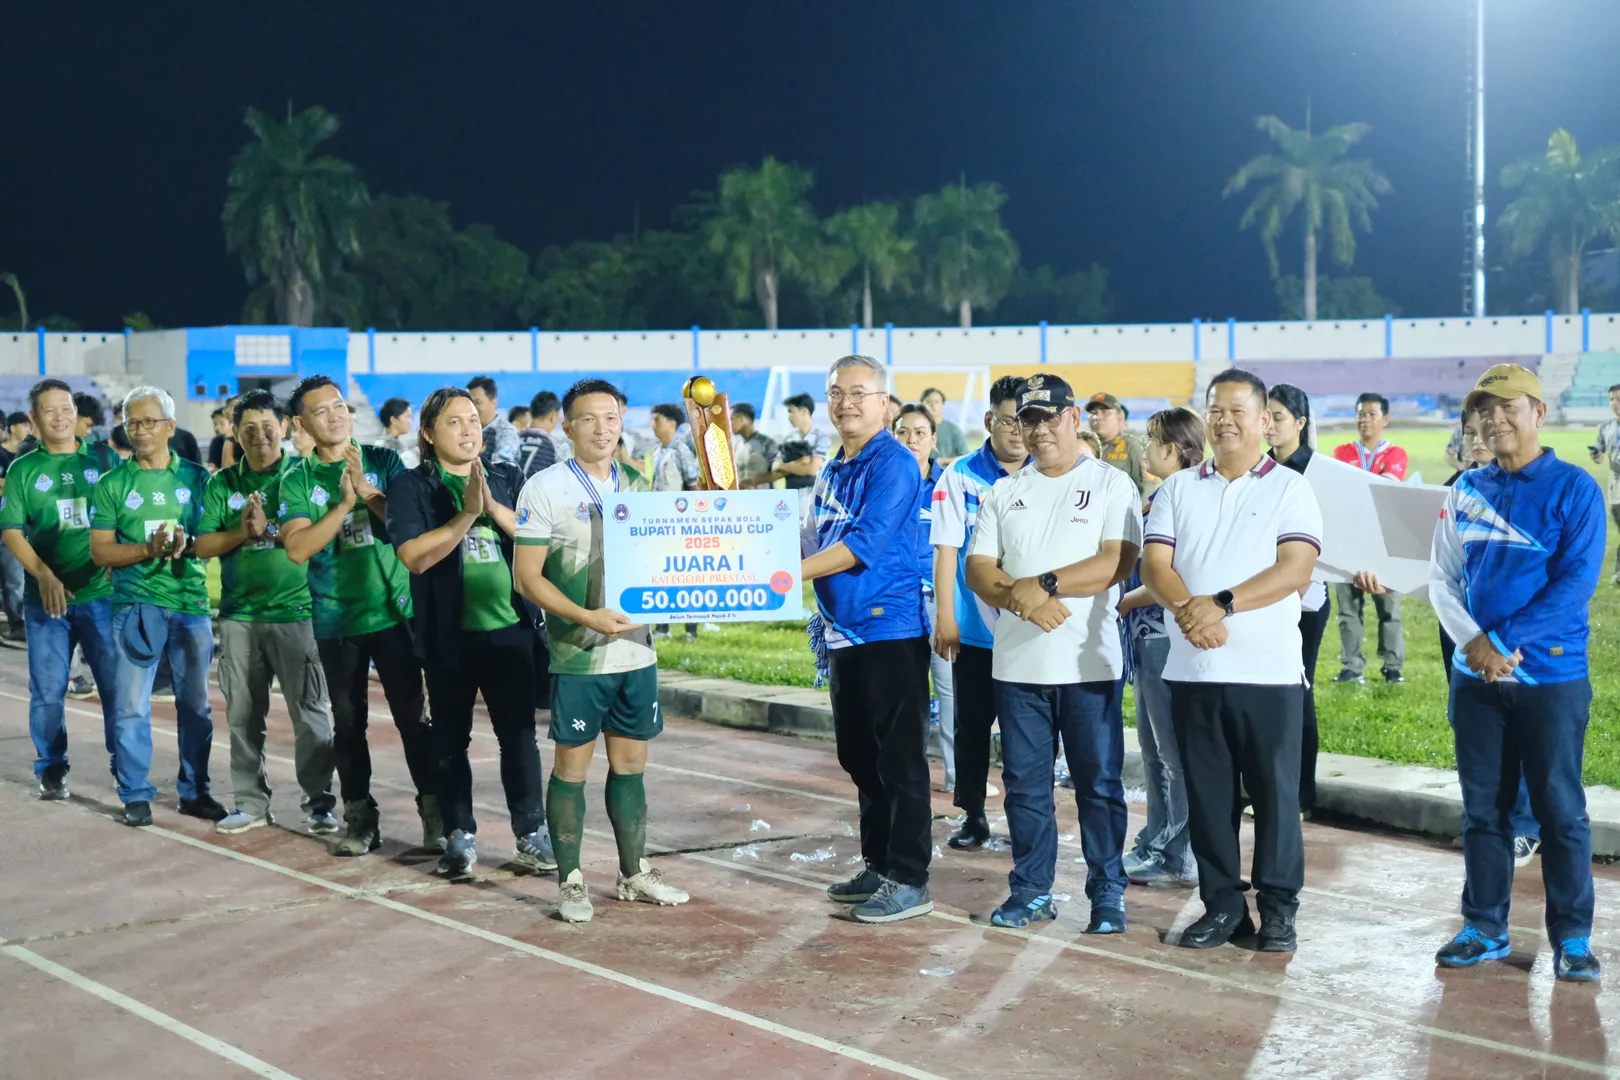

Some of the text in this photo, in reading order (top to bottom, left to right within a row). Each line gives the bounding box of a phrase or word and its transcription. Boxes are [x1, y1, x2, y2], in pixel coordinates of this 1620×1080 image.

[521, 445, 539, 481] 7
[642, 516, 698, 524] TURNAMEN
[630, 524, 774, 537] BUPATI MALINAU CUP
[684, 537, 720, 549] 2025
[663, 554, 744, 573] JUARA I
[709, 573, 757, 583] PRESTASI
[641, 589, 767, 609] 50.000.000
